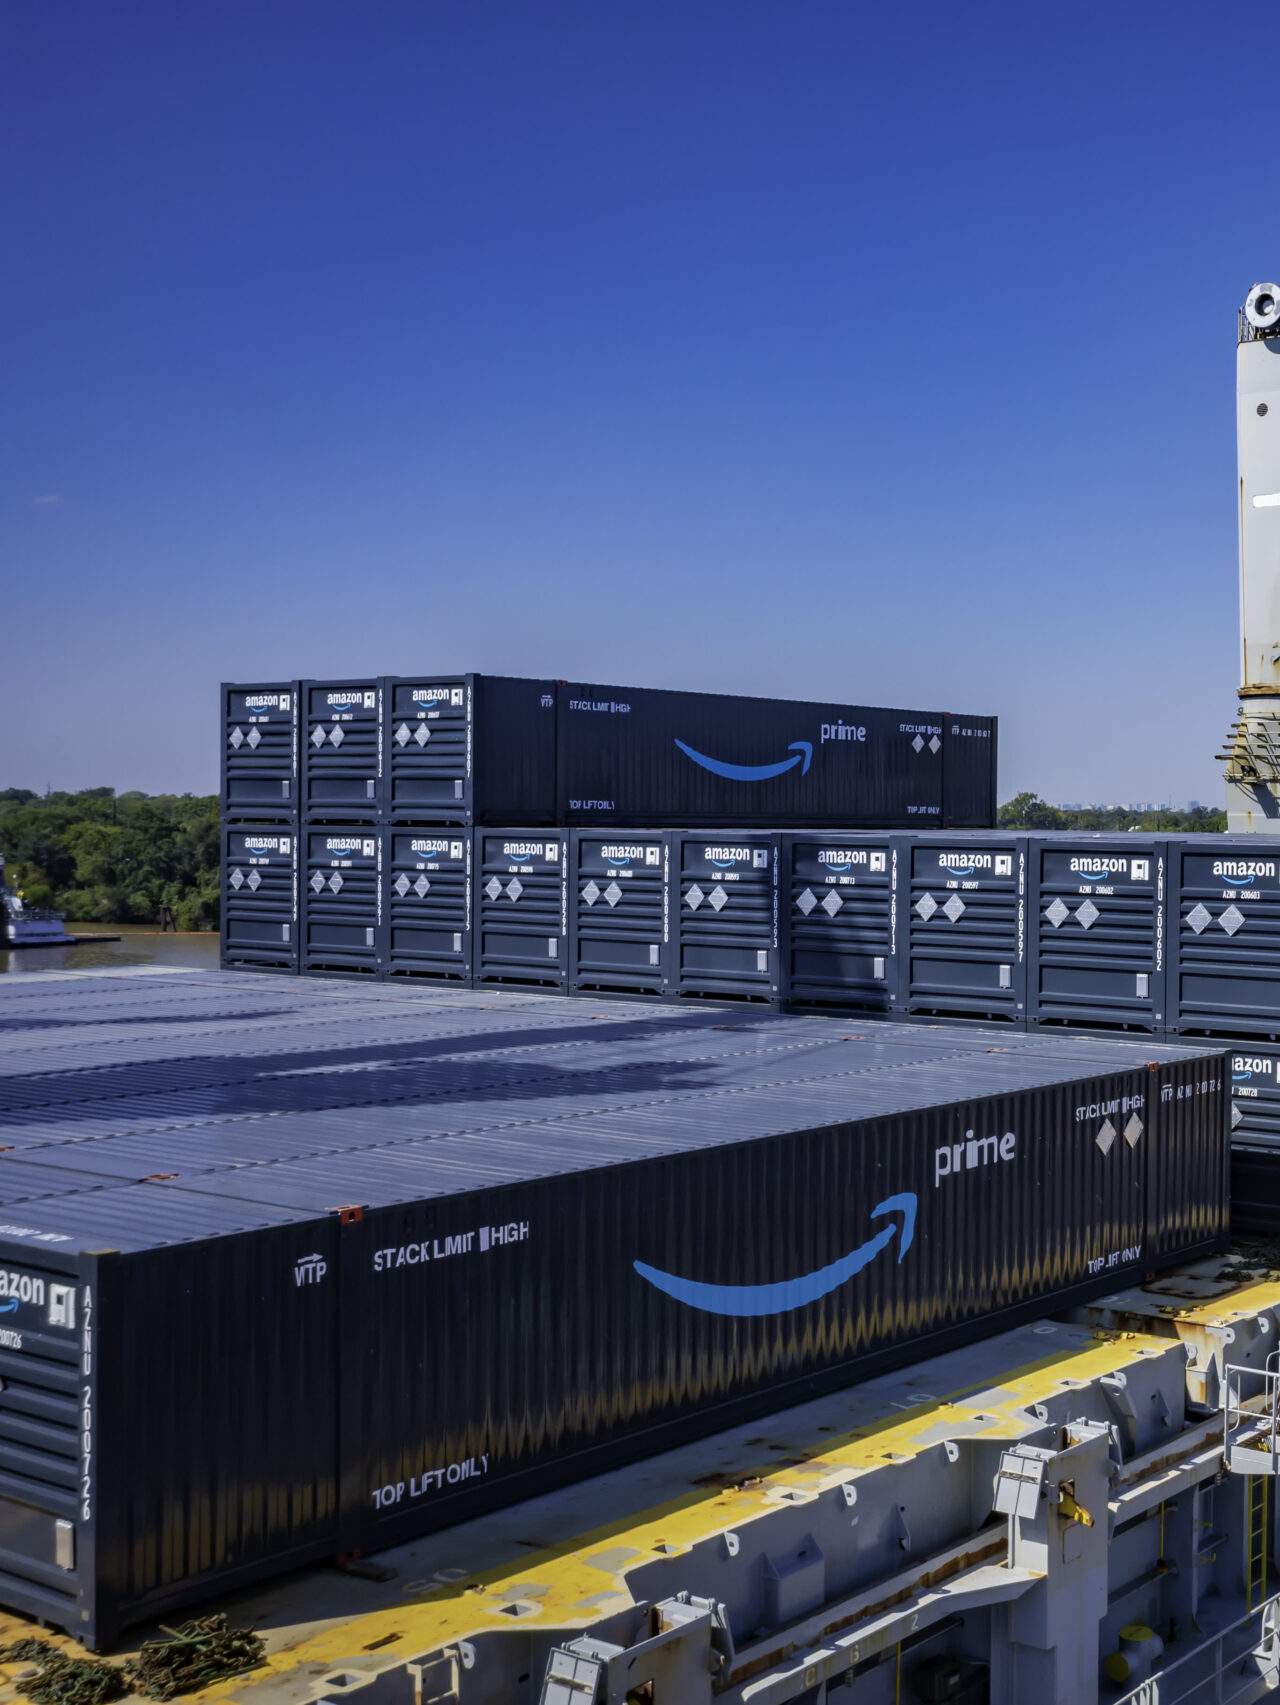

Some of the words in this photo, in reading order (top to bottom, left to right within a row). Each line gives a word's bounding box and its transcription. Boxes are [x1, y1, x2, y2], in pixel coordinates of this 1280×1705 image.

[244, 695, 279, 707] amazon
[327, 692, 362, 704] amazon
[412, 688, 449, 701] amazon
[821, 720, 866, 743] prime
[243, 837, 277, 849] amazon
[325, 838, 361, 850] amazon
[410, 839, 448, 852] amazon
[502, 843, 543, 855] amazon
[601, 846, 643, 859] amazon
[703, 847, 749, 861] amazon
[816, 850, 866, 864] amazon
[938, 853, 992, 868] amazon
[1070, 857, 1127, 872] amazon
[1212, 861, 1276, 877] amazon
[1222, 889, 1236, 900] AZNU
[1240, 891, 1261, 901] 200603
[662, 886, 670, 943] 200600
[771, 889, 779, 949] 200593
[889, 894, 898, 956] 200713
[1017, 899, 1025, 963] 200597
[1156, 905, 1164, 972] 200602
[1232, 1057, 1272, 1075] azon
[1237, 1086, 1259, 1098] 200728
[936, 1130, 1015, 1187] prime
[373, 1241, 430, 1272] STACK
[0, 1268, 46, 1305] azon
[83, 1286, 92, 1376] AZNU
[82, 1385, 92, 1521] 200726
[372, 1483, 405, 1510] TOP
[446, 1452, 489, 1484] ONLY
